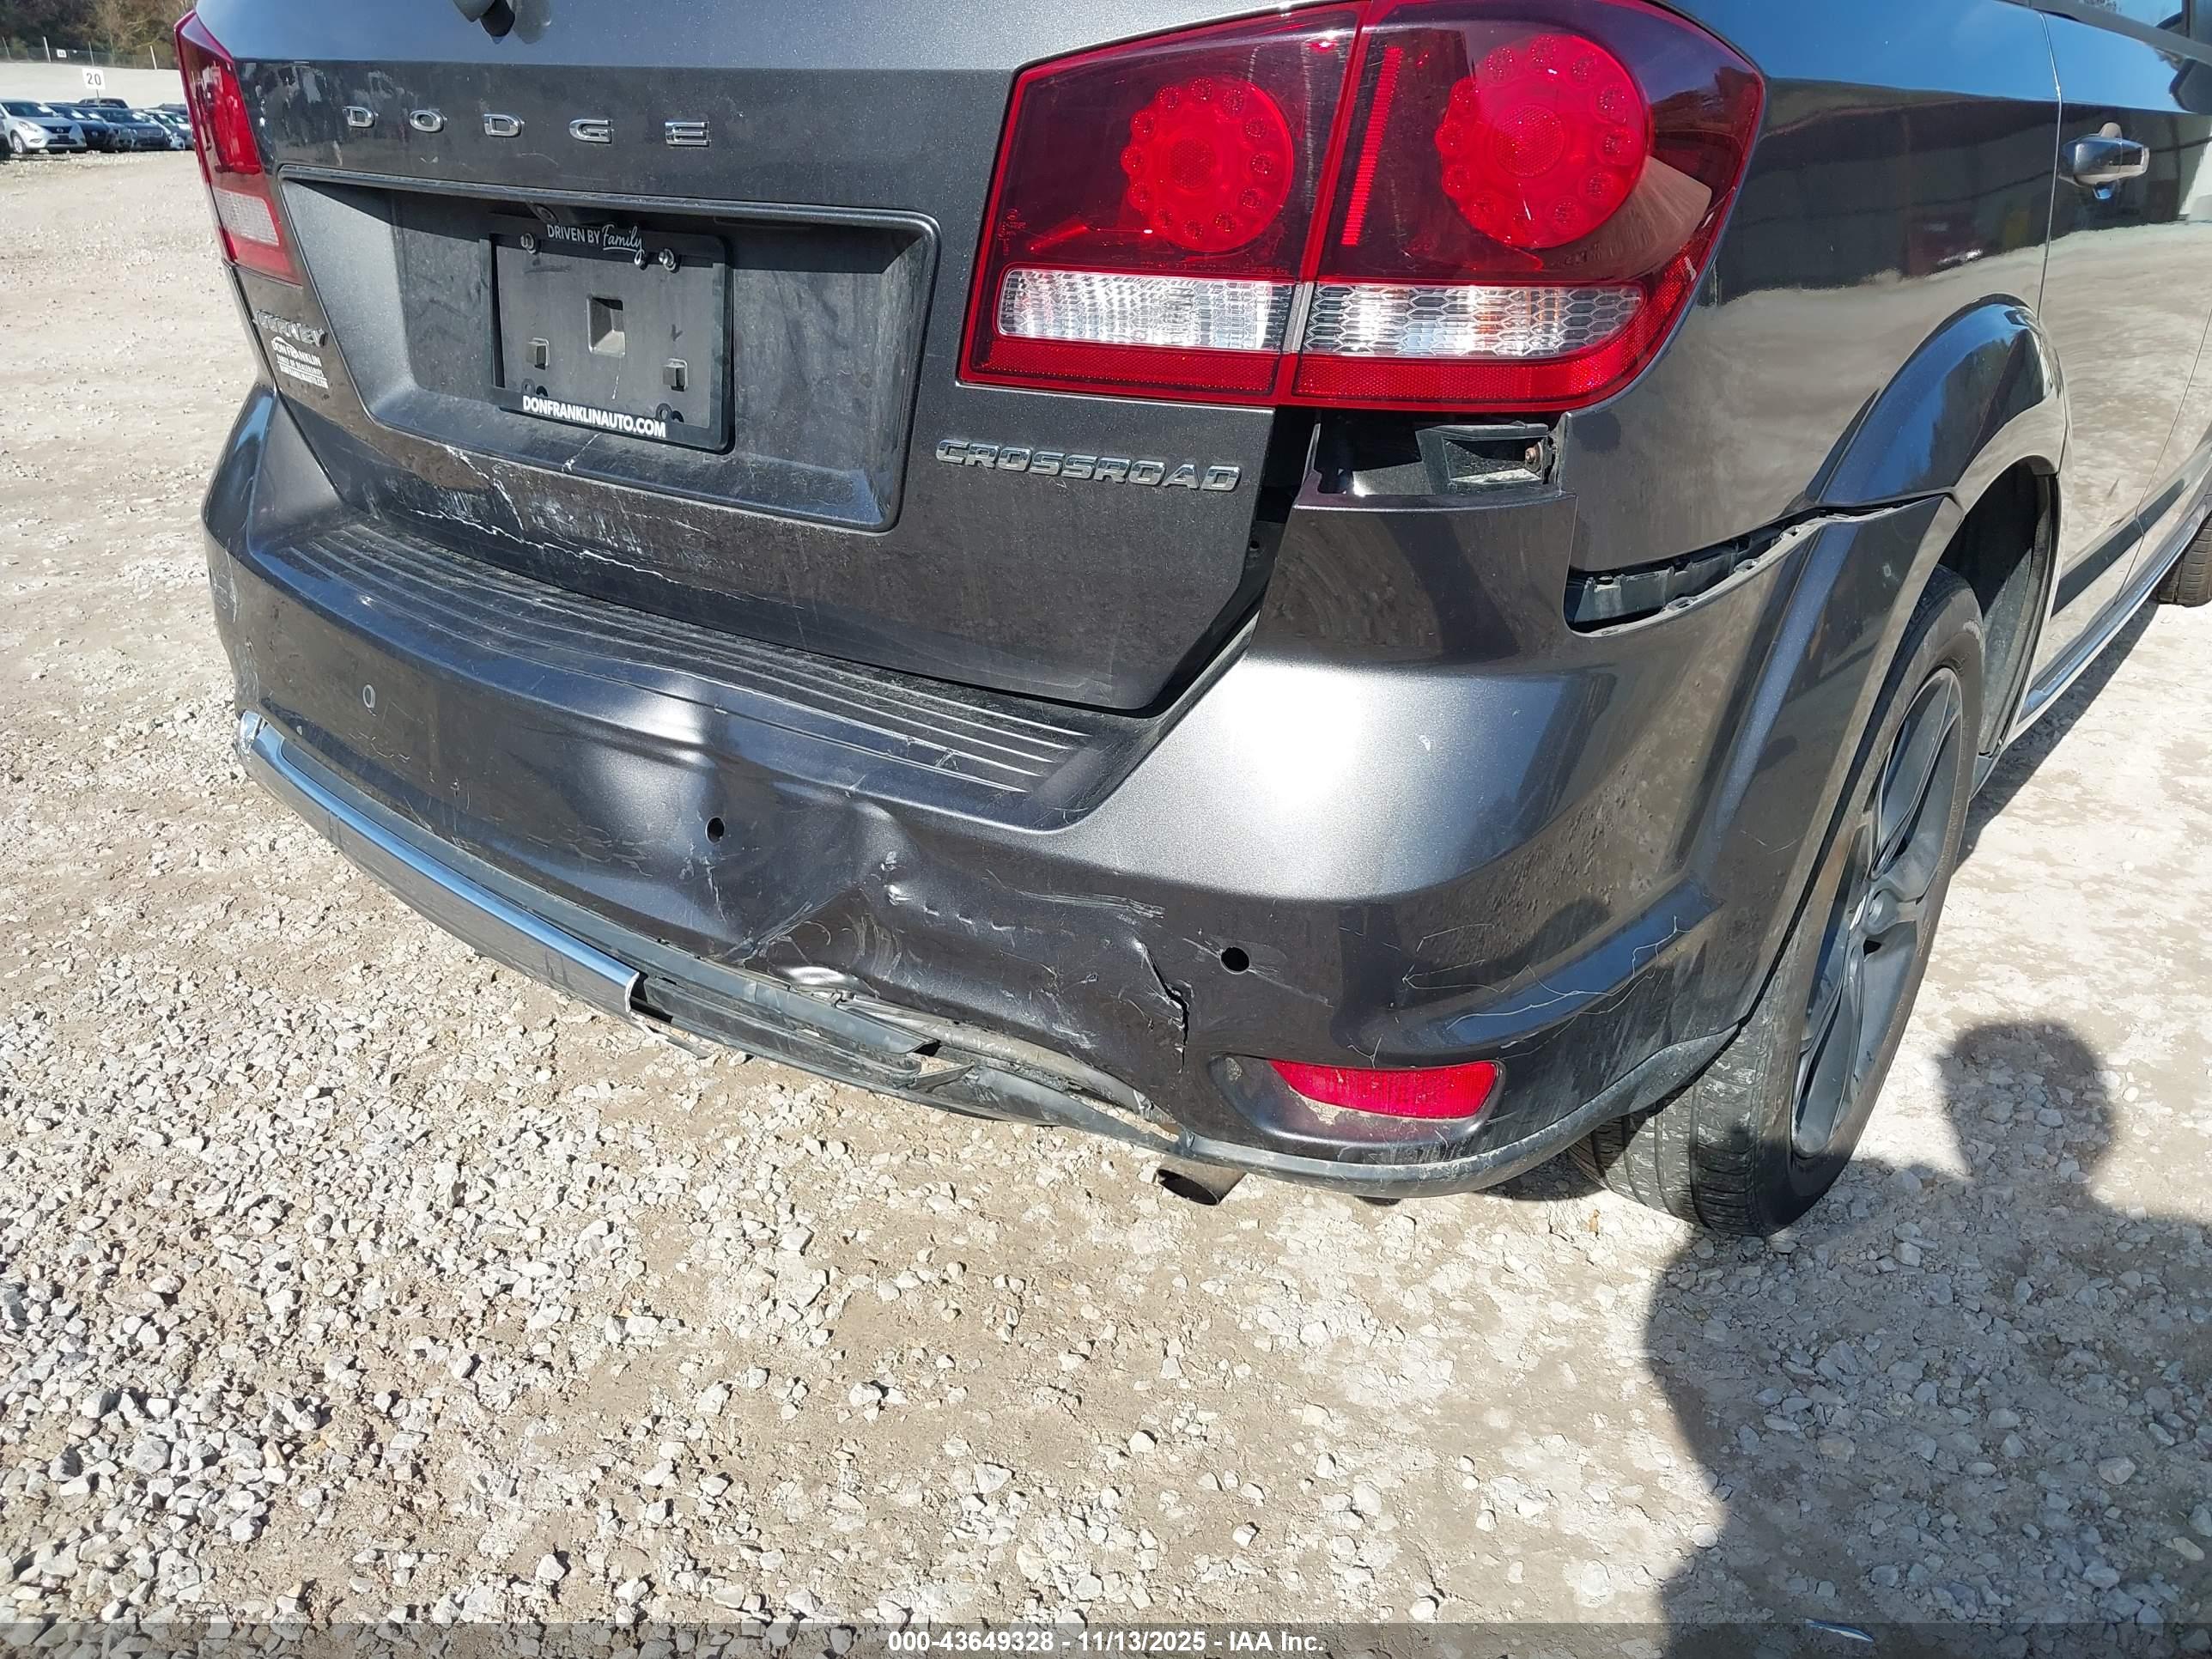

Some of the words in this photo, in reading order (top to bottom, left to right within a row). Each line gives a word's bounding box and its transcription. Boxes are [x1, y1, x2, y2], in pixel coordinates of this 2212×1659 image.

[87, 72, 101, 86] 20
[343, 106, 711, 147] DODGE
[547, 224, 586, 242] DRIVEN
[587, 228, 600, 245] BY
[602, 223, 644, 261] Family
[523, 396, 666, 438] DONFRANKLINAUTO.COM
[935, 439, 1242, 493] CROSSROAD
